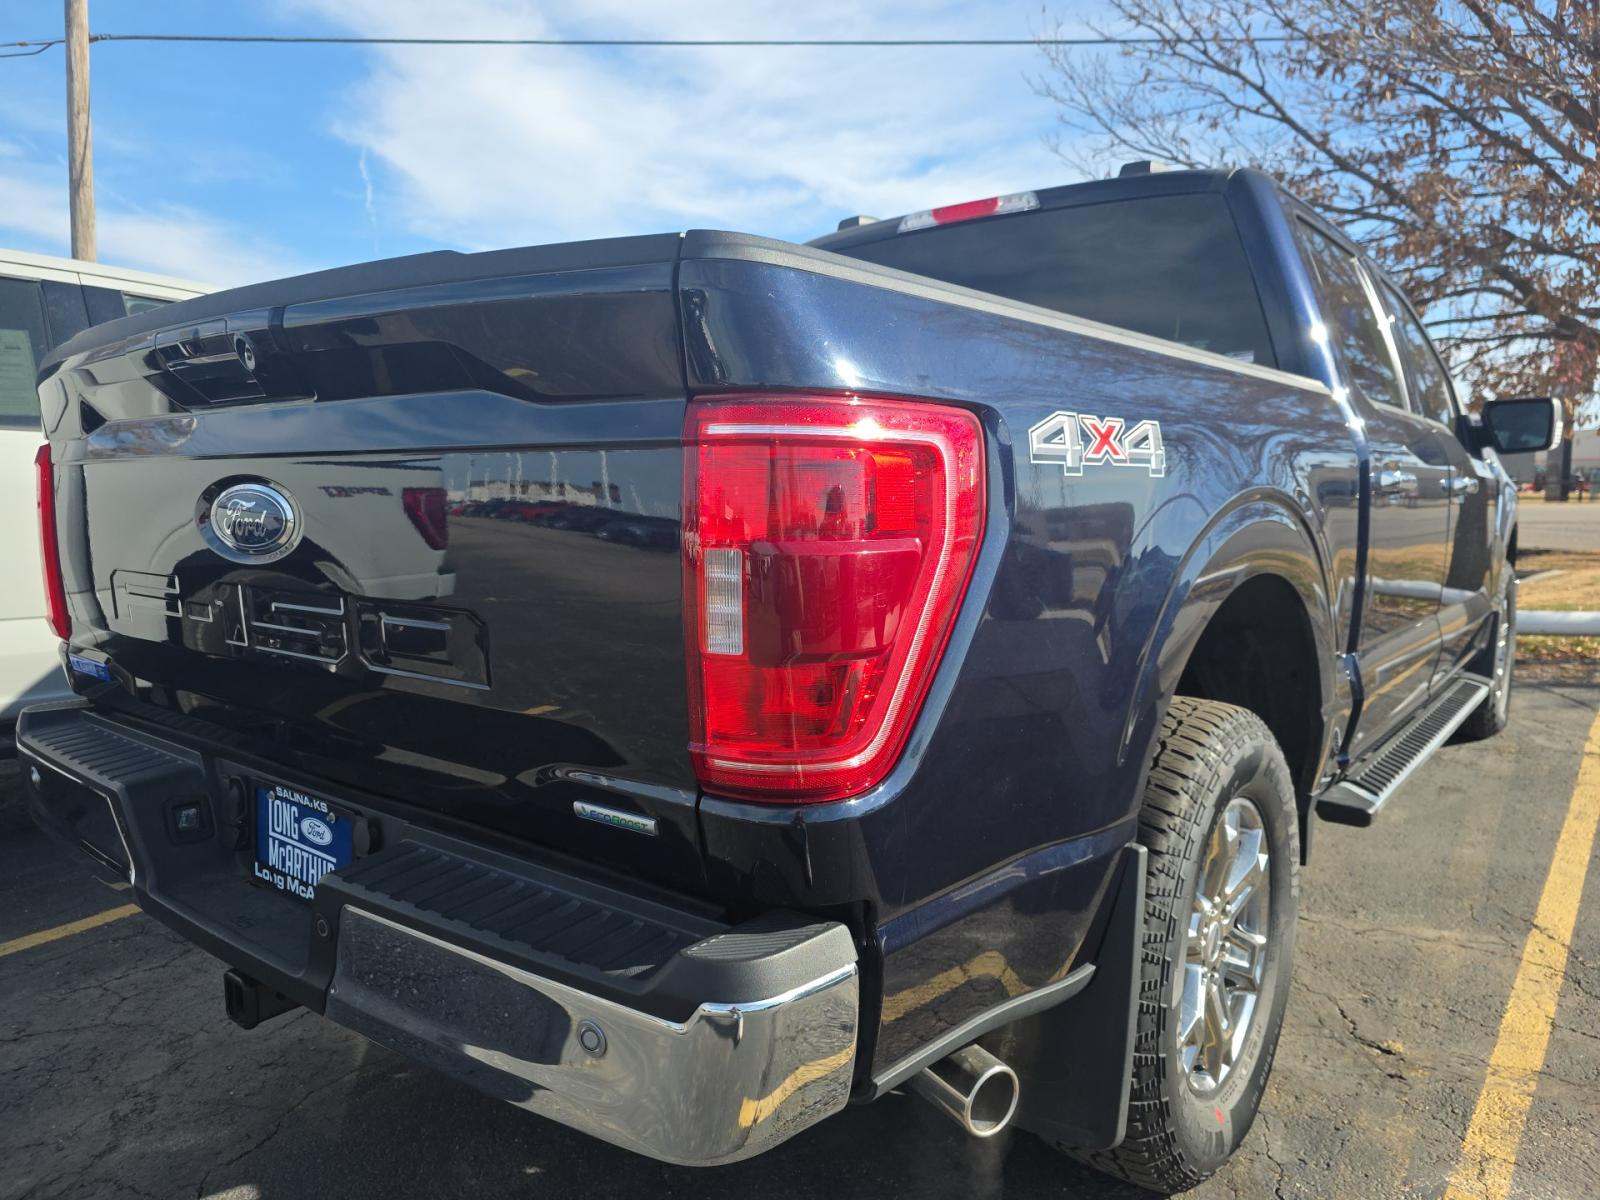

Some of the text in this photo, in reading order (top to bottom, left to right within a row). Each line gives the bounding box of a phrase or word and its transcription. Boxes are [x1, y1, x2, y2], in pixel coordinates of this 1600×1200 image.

[223, 498, 267, 537] Ford
[110, 568, 492, 690] F-150
[268, 798, 299, 841] LONG
[306, 821, 326, 841] Ford
